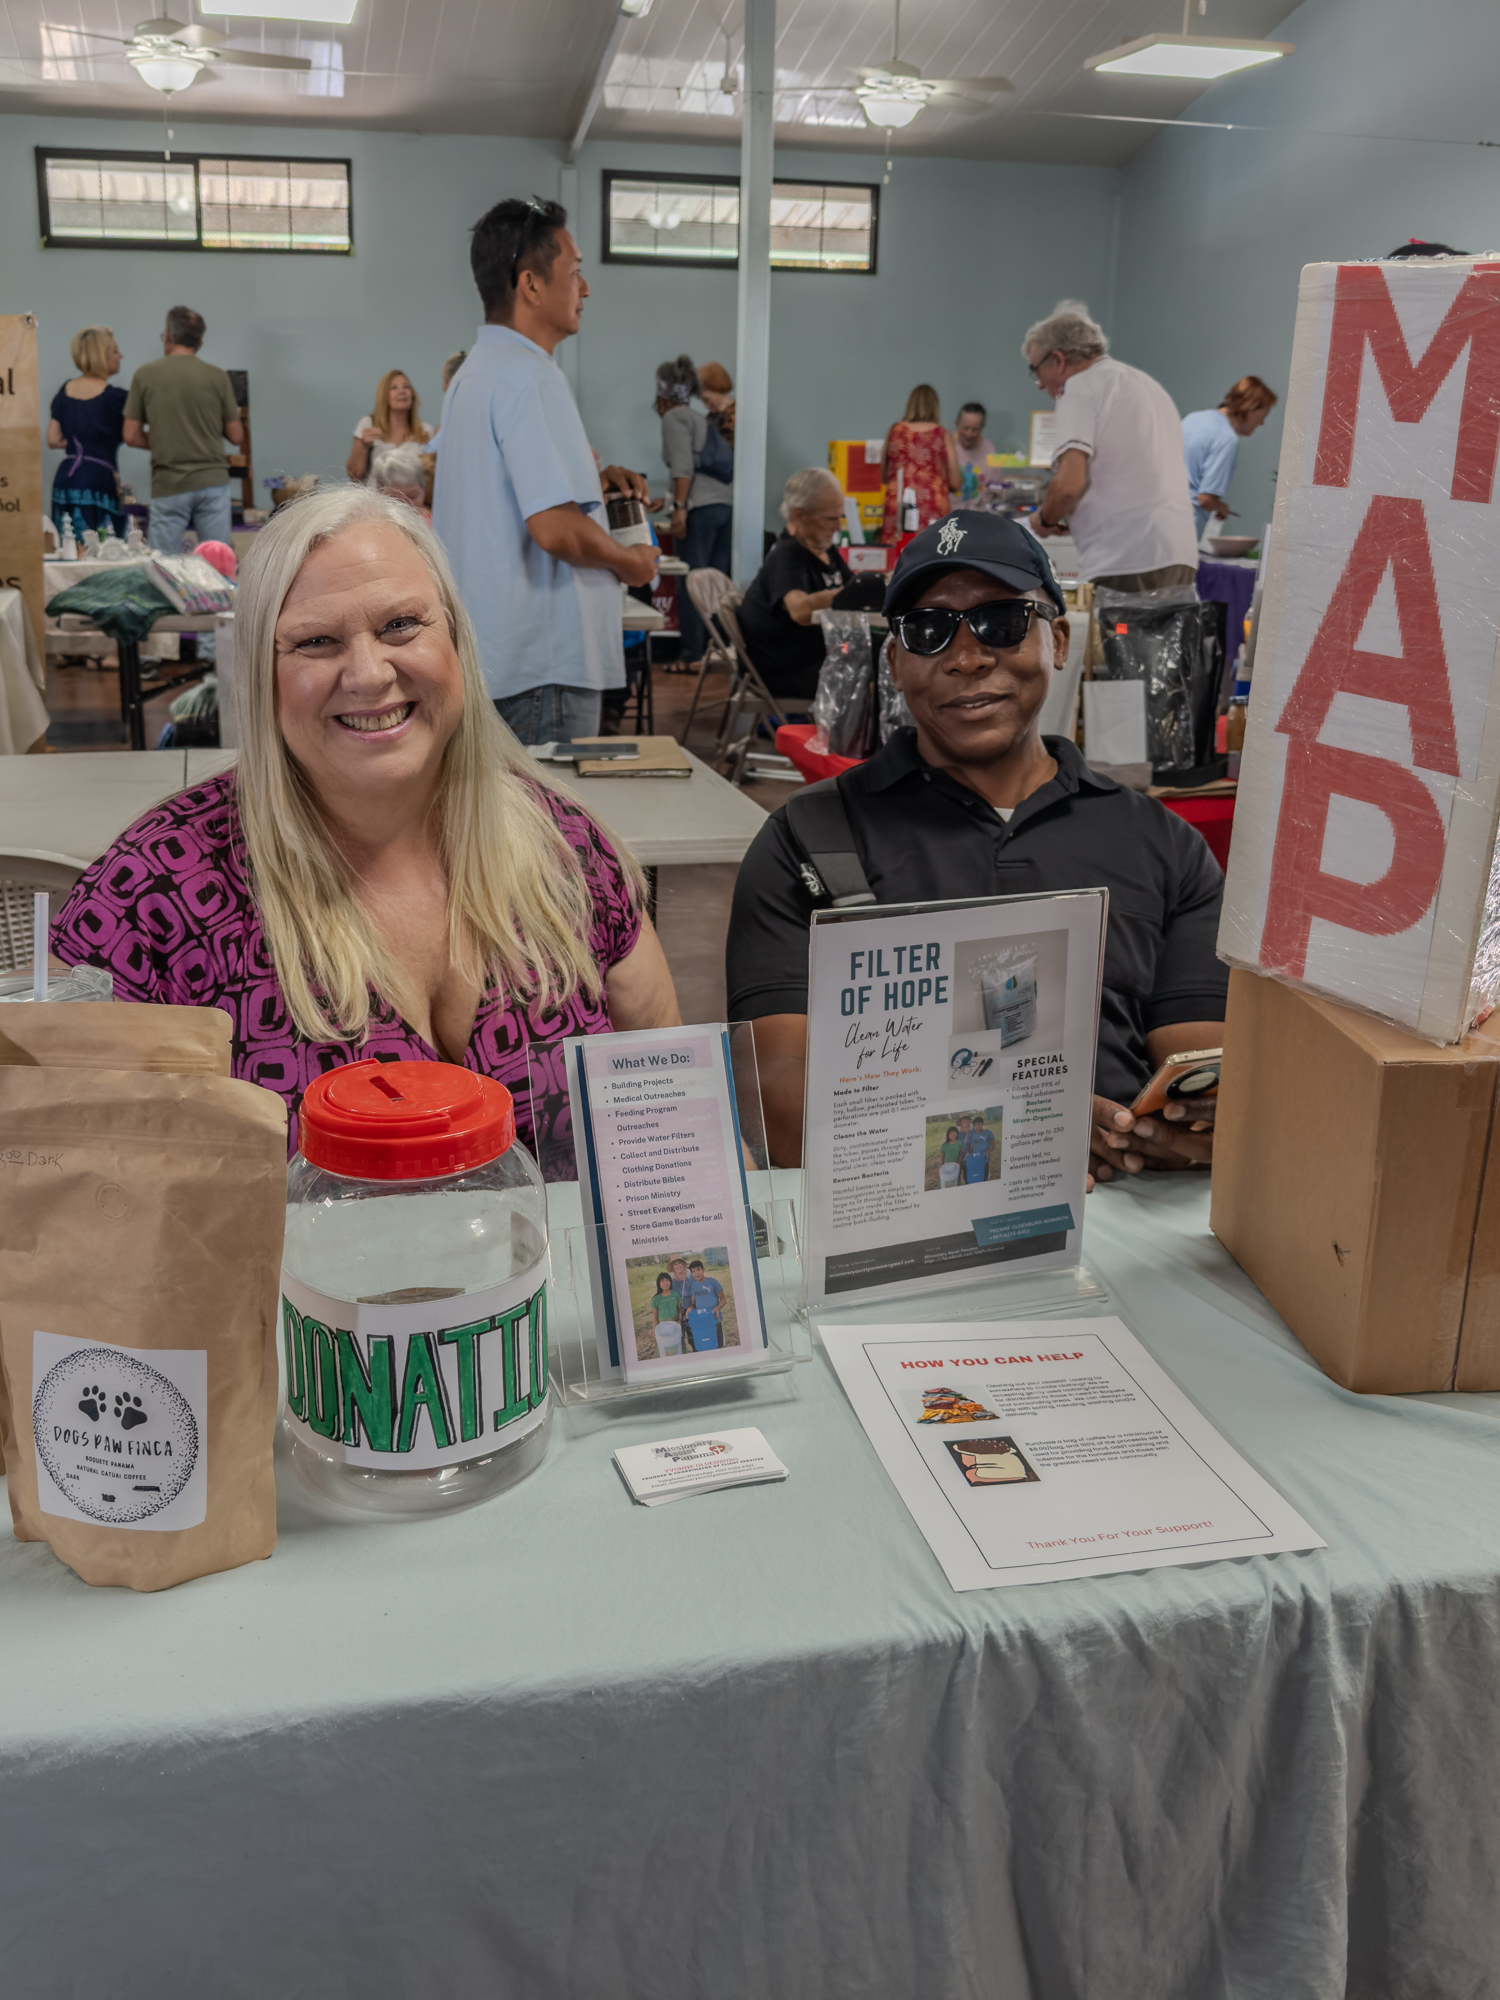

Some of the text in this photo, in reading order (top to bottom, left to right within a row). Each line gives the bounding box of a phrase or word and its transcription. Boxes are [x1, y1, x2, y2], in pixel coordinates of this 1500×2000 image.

[1258, 262, 1500, 978] MAP
[850, 942, 940, 981] FILTER
[841, 975, 949, 1016] OF HOPE
[844, 1015, 923, 1048] Clean Water
[855, 1035, 909, 1070] for Life
[612, 1051, 691, 1071] What We Do:
[1017, 1053, 1065, 1069] SPECIAL
[839, 1075, 862, 1083] Here's
[901, 1066, 922, 1074] Work:
[1012, 1064, 1068, 1081] FEATURES
[611, 1077, 674, 1090] Building Projects
[613, 1090, 686, 1104] Medical Outreaches
[834, 1089, 852, 1097] Made
[1026, 1097, 1052, 1106] Bacteria
[614, 1106, 678, 1118] Feeding Program
[1025, 1106, 1052, 1114] Protozoa
[1012, 1112, 1063, 1124] Micro-Organisms
[616, 1121, 660, 1132] Outreaches
[618, 1132, 696, 1146] Provide Water Filters
[833, 1133, 855, 1141] Cleans
[869, 1127, 888, 1135] Water
[620, 1145, 700, 1160] Collect and Distribute
[621, 1161, 693, 1174] Clothing Donations
[623, 1175, 686, 1188] Distribute Bibles
[833, 1169, 889, 1184] Removes Bacteria
[625, 1190, 682, 1203] Prison Ministry
[627, 1203, 696, 1217] Street Evangelism
[629, 1223, 651, 1231] Store
[651, 1220, 674, 1228] Game
[674, 1216, 701, 1225] Boards
[713, 1212, 723, 1220] all
[631, 1235, 669, 1245] Ministries
[900, 1352, 1084, 1369] HOW YOU CAN HELP
[54, 1426, 173, 1457] DOGS PAW FINCA
[655, 1441, 714, 1453] Missionary
[663, 1448, 696, 1458] Assist
[672, 1451, 720, 1462] Panama
[85, 1455, 134, 1469] BOQUETE PANAMÁ
[1026, 1520, 1214, 1549] Thank You For Your Support!
